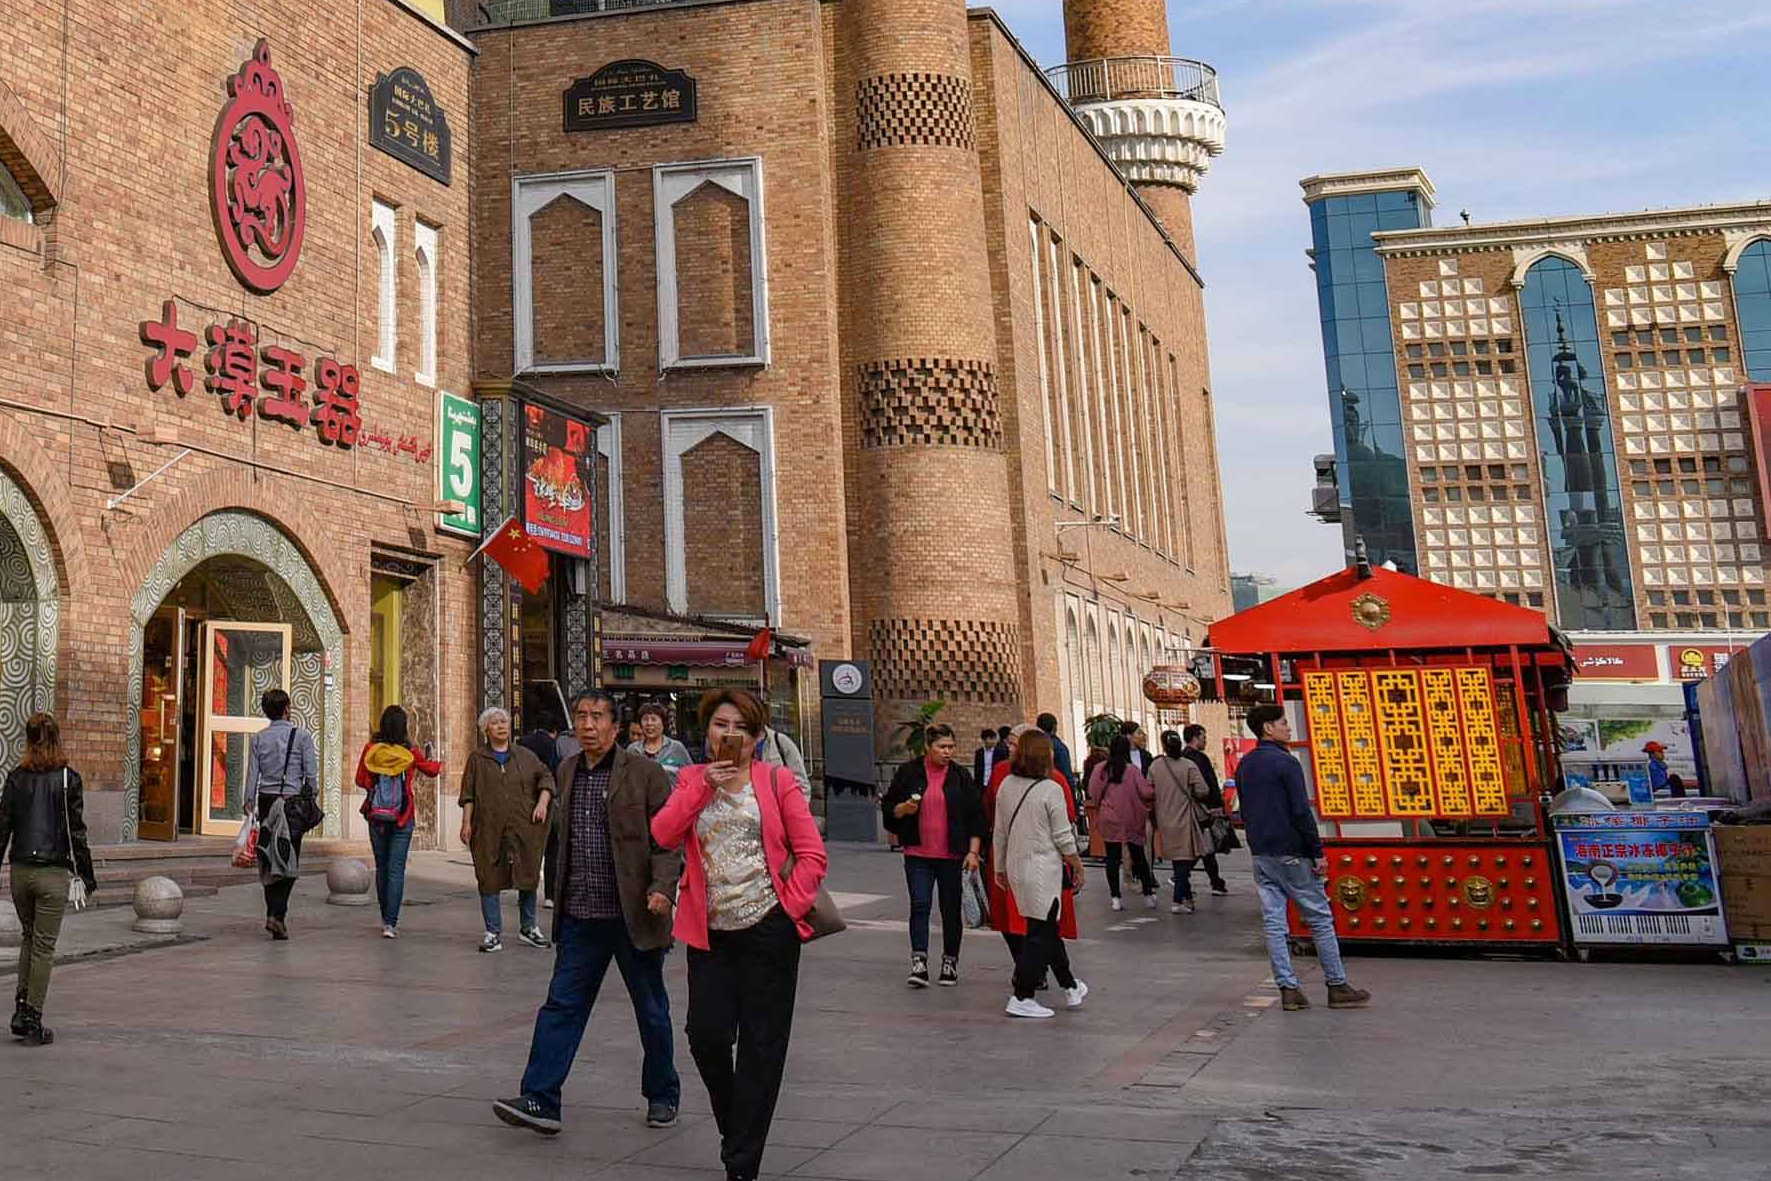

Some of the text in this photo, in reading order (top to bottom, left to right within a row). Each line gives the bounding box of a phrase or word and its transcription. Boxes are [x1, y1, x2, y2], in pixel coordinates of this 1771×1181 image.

[578, 88, 681, 116] 民族工艺馆
[385, 107, 439, 161] 5号楼
[139, 299, 362, 449] 大漠玉器
[449, 430, 473, 498] 5
